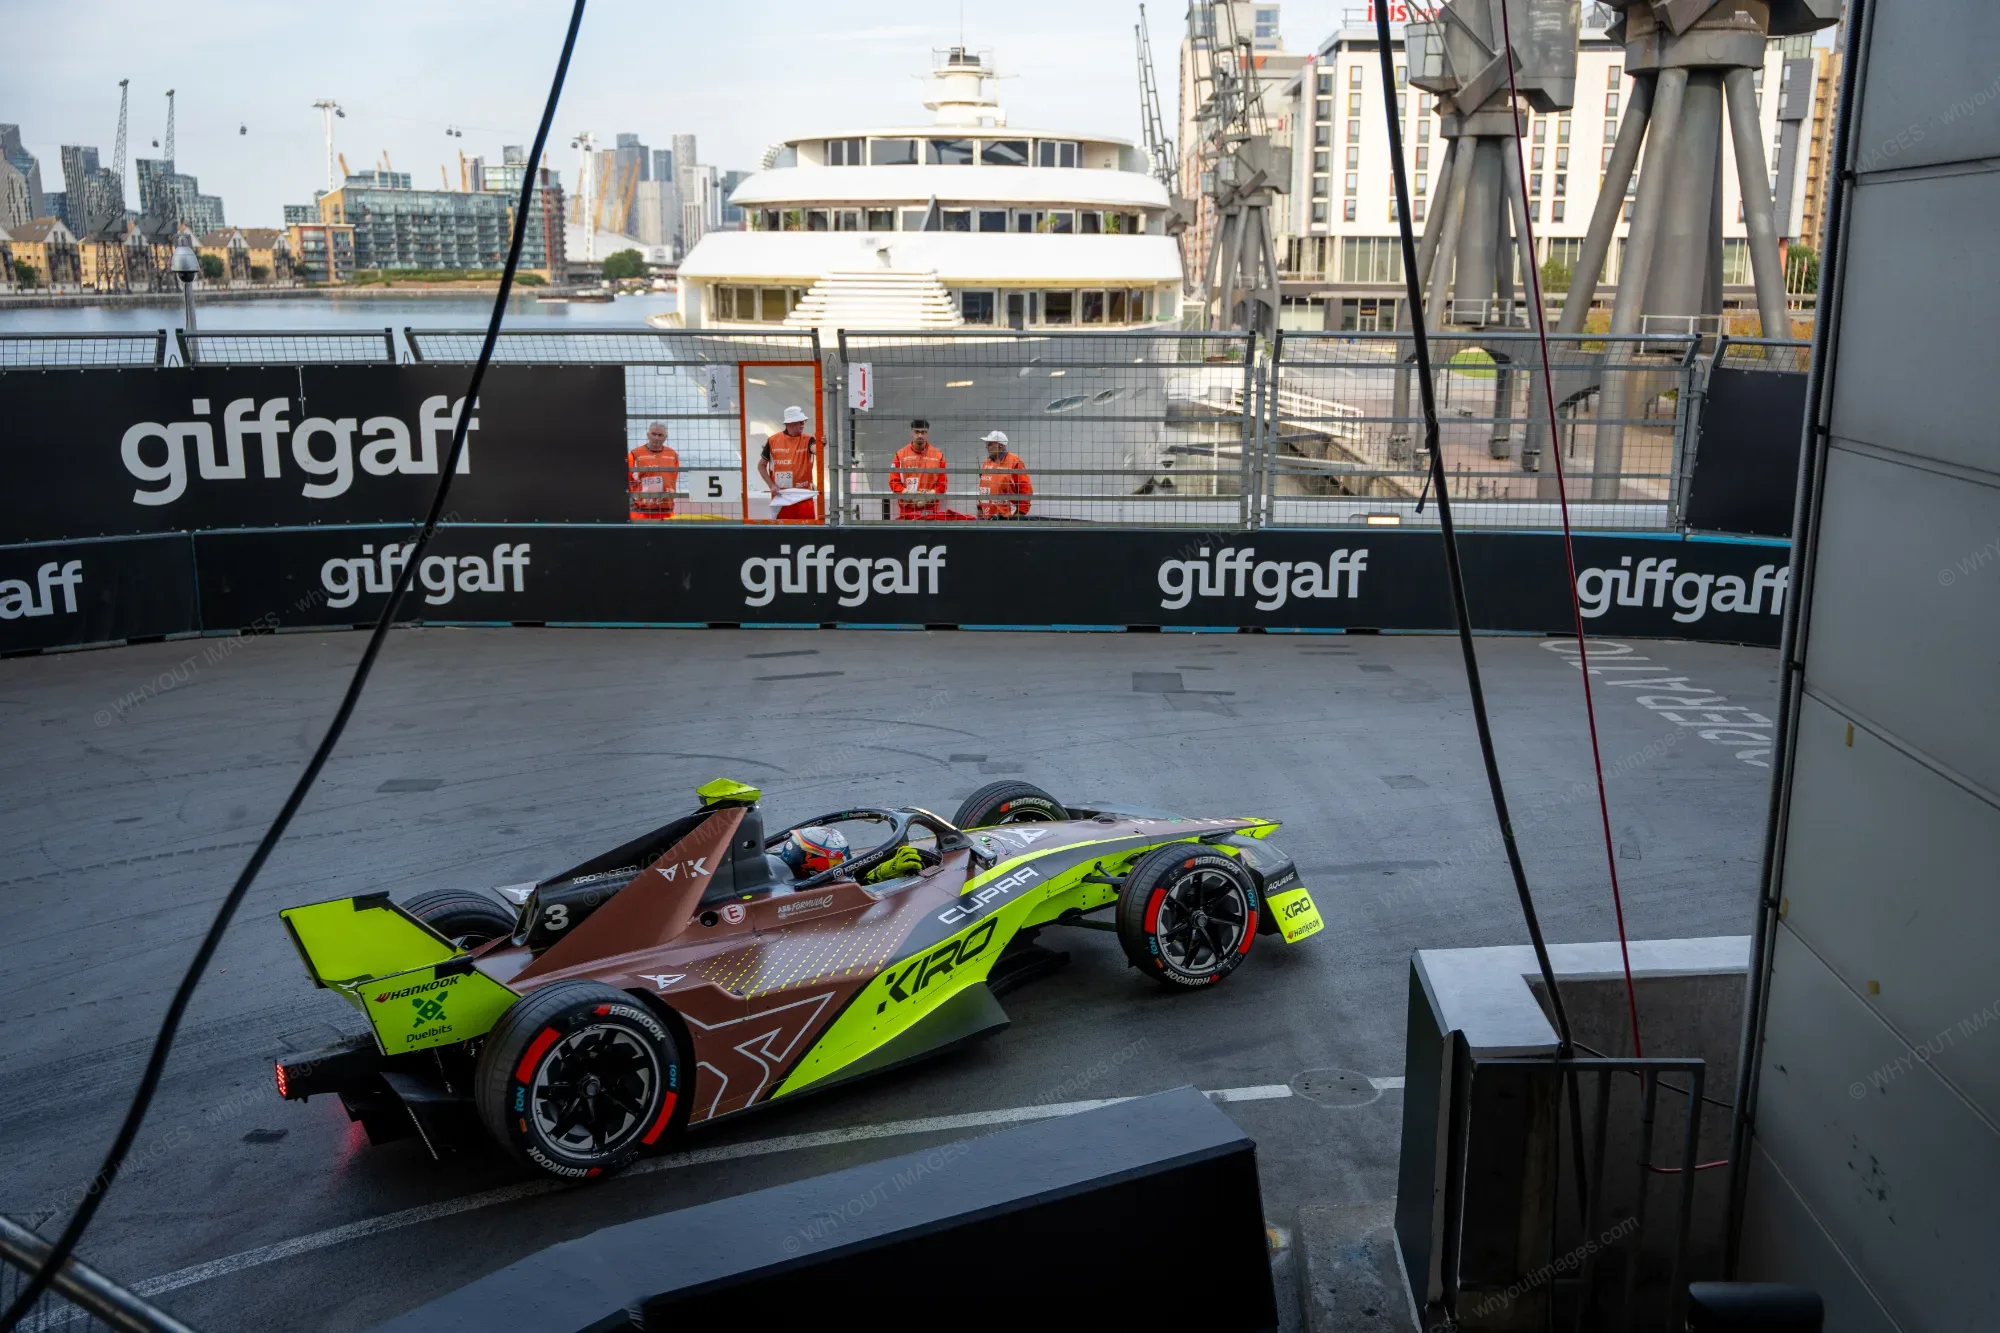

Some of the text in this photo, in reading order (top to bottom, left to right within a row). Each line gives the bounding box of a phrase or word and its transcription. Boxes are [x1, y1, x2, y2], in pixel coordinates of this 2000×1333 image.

[1367, 0, 1407, 22] iis
[120, 395, 480, 506] giffgaff
[708, 476, 723, 497] 5
[320, 542, 531, 609] giffgaff
[740, 544, 947, 607] giffgaff
[1157, 546, 1369, 611] giffgaff
[1576, 556, 1790, 623] giffgaff
[544, 904, 569, 931] 3
[727, 905, 740, 919] E
[938, 866, 1040, 925] CUPRA
[1281, 896, 1311, 921] KIRO
[876, 917, 999, 1015] KIRO
[406, 1024, 453, 1043] Duelbits
